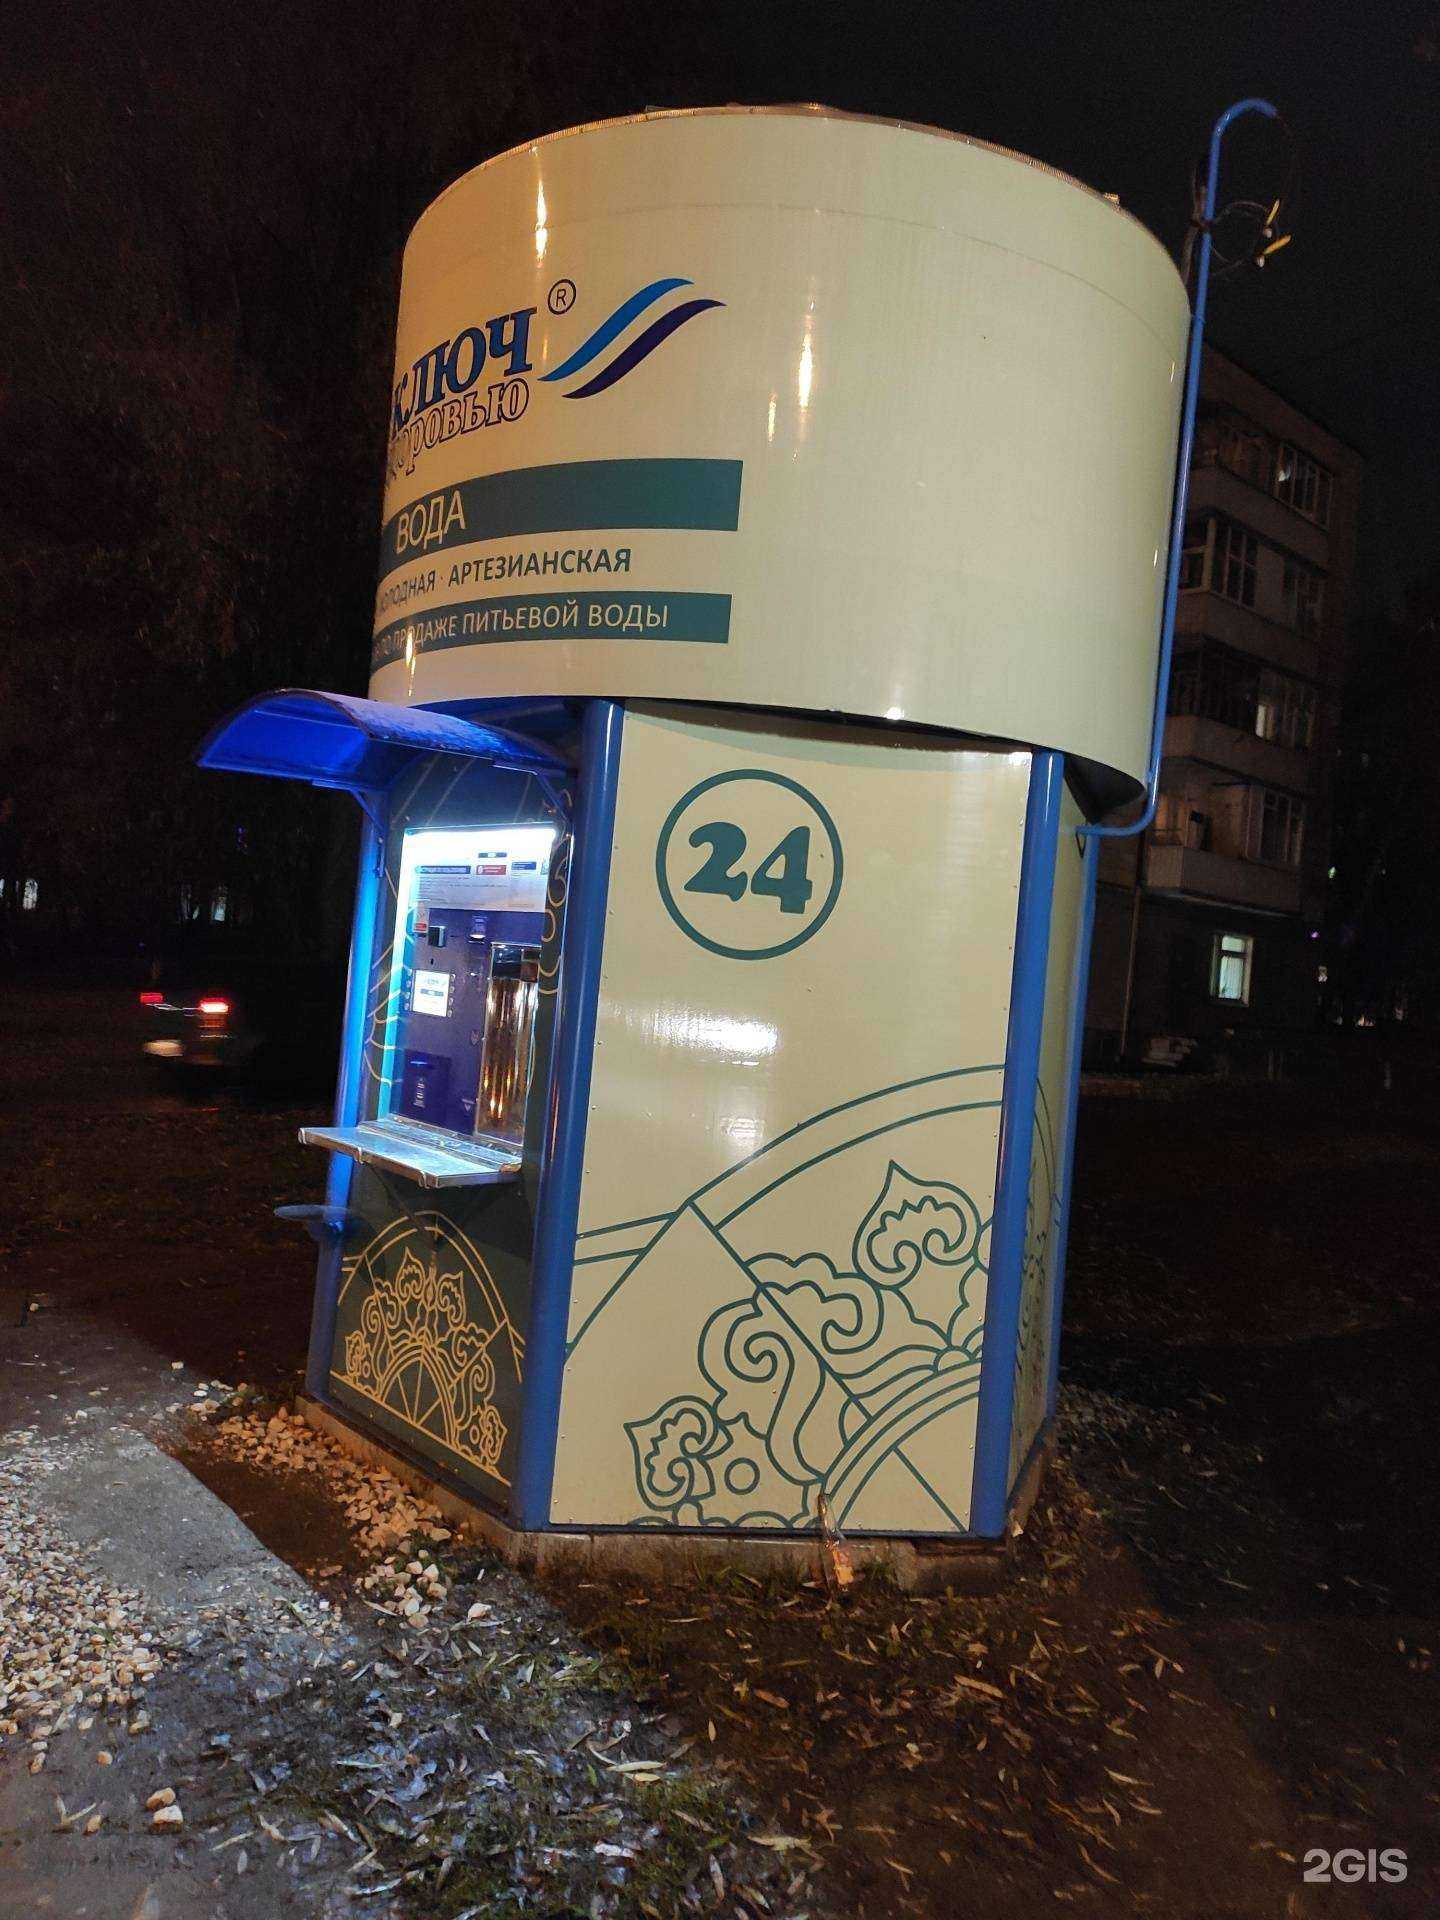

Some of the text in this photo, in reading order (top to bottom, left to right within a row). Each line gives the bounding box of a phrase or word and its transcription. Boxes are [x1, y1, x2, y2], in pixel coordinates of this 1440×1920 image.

[396, 490, 466, 554] ВОДА
[448, 548, 632, 588] АРТЕЗИАНСКАЯ
[462, 599, 580, 635] ПИТЬЕВОЙ
[587, 603, 669, 633] ВОДЫ
[683, 821, 813, 914] 24
